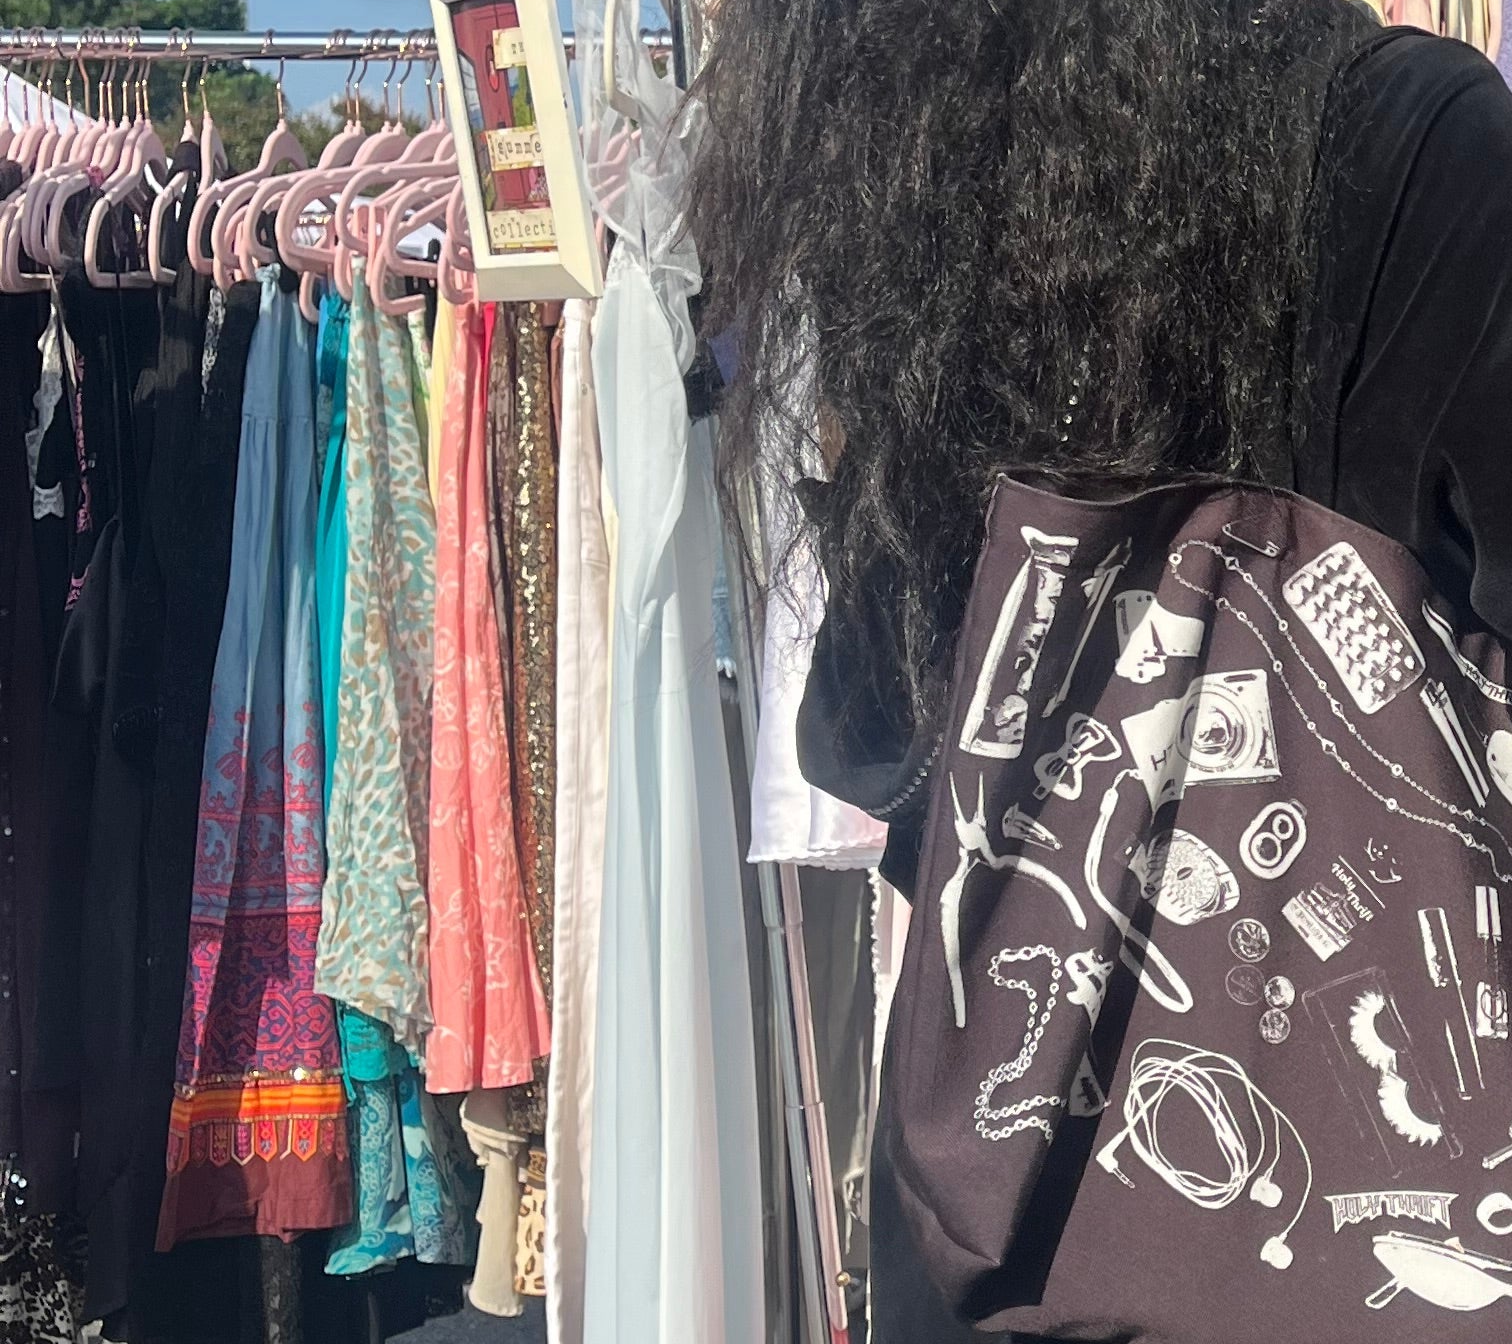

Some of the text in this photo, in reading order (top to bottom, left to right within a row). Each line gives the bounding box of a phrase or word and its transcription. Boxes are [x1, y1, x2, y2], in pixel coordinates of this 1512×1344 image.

[1331, 862, 1374, 922] Holy Thrift
[1332, 1193, 1450, 1228] HOLY THRIFT
